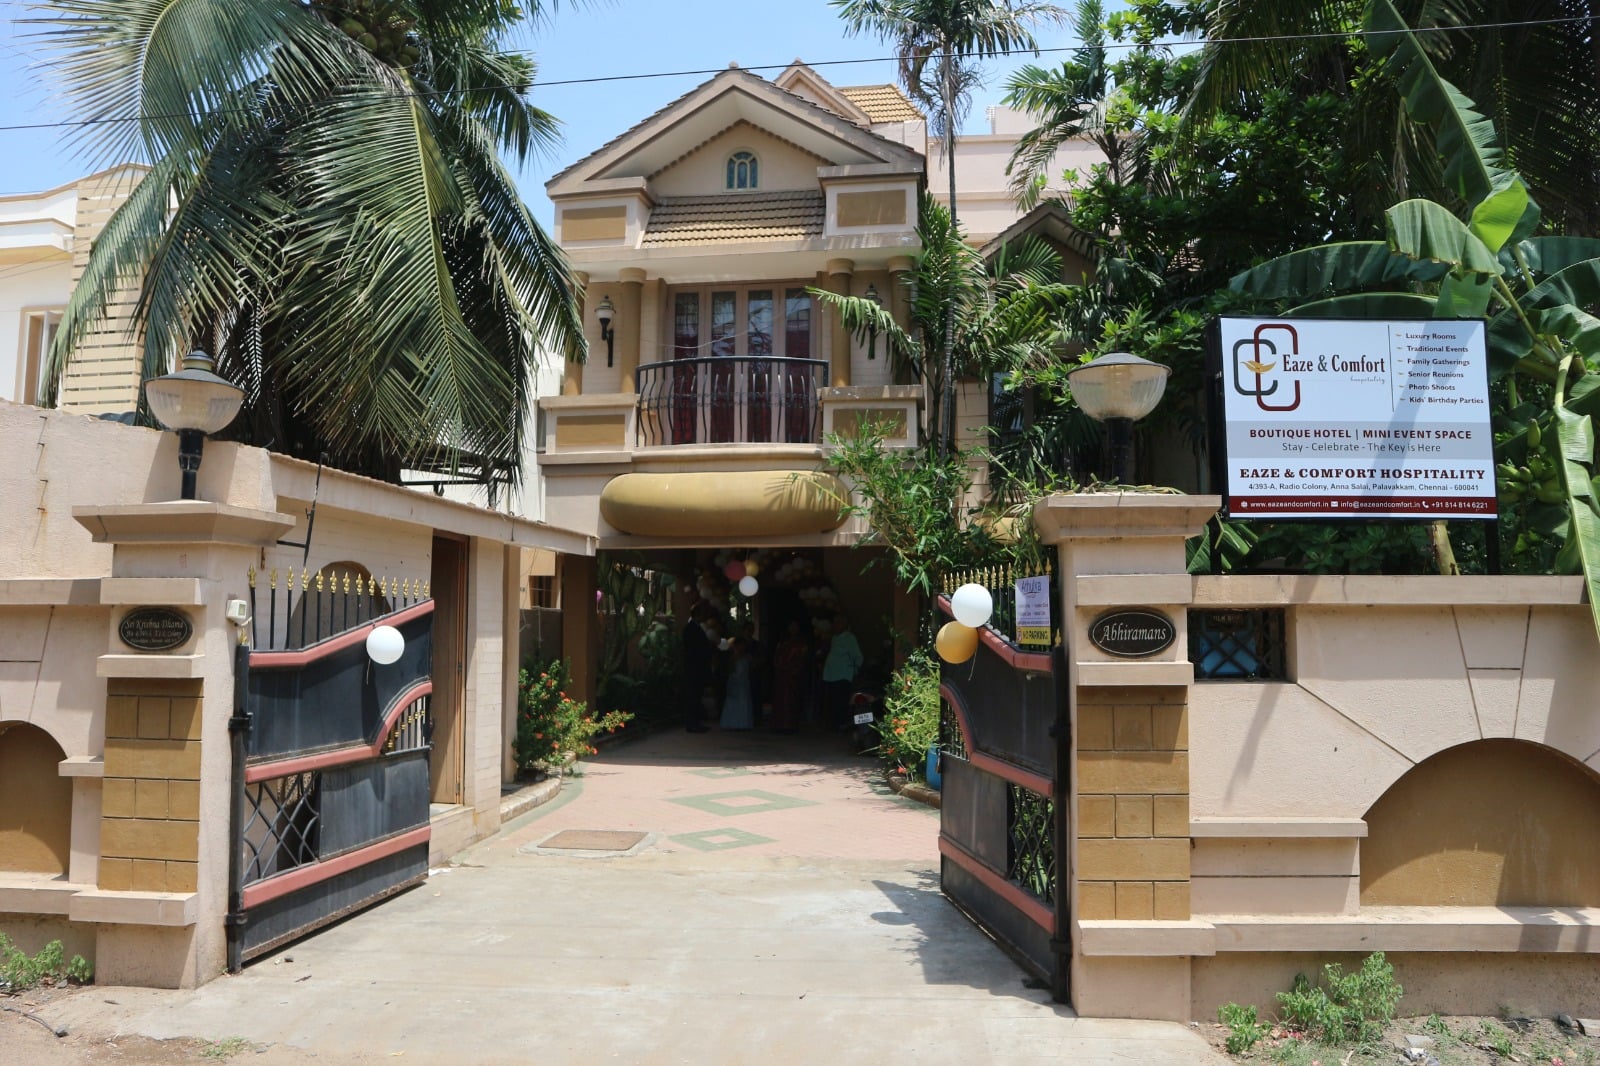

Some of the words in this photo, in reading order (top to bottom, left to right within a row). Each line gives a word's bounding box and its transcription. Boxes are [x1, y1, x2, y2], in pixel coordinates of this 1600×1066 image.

[1282, 354, 1313, 372] Eaze
[1318, 354, 1328, 372] &
[1332, 354, 1385, 372] Comfort
[1250, 430, 1310, 438] BOUTIQUE
[1314, 430, 1352, 438] HOTEL
[1363, 430, 1390, 438] MINI
[1394, 430, 1432, 438] EVENT
[1435, 430, 1472, 439] SPACE
[1282, 442, 1302, 452] Stay
[1312, 442, 1359, 451] Celebrate
[1368, 443, 1386, 452] The
[1388, 443, 1406, 453] Key
[1408, 444, 1415, 452] is
[1240, 469, 1280, 478] EAZE
[1284, 469, 1295, 478] &
[1299, 469, 1376, 478] COMFORT
[1380, 469, 1485, 480] HOSPITALITY
[1030, 630, 1048, 640] PARKING
[1099, 622, 1166, 644] Abhiramans
